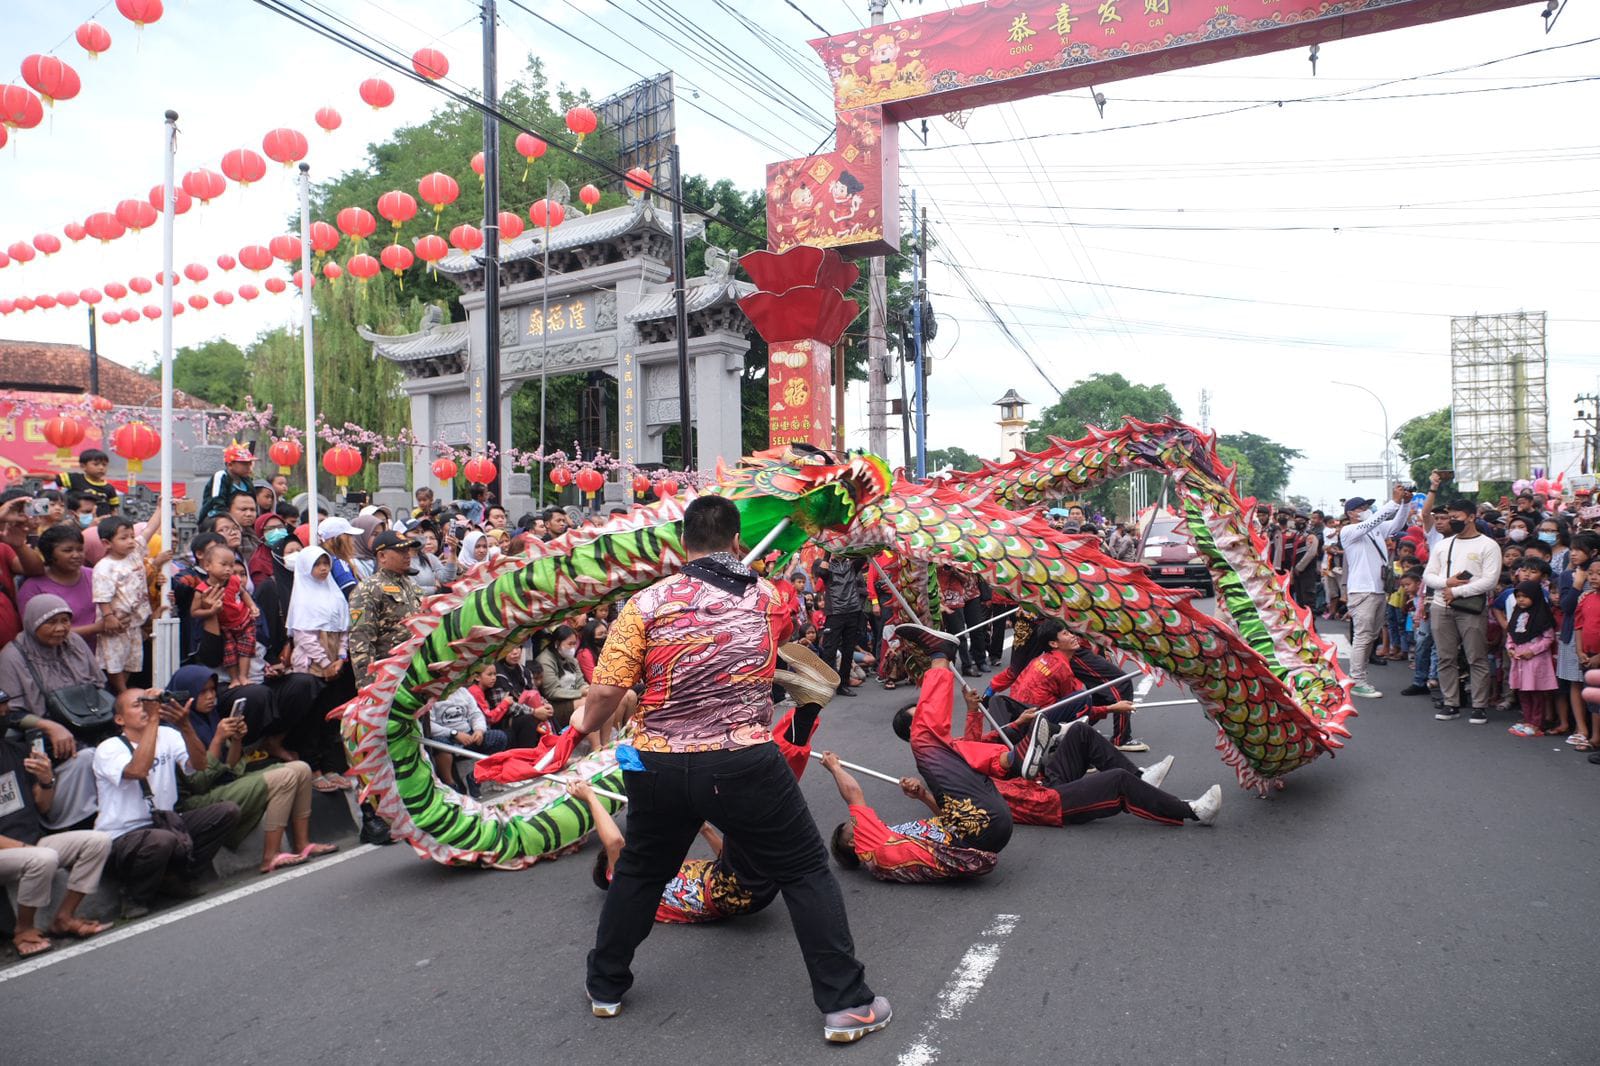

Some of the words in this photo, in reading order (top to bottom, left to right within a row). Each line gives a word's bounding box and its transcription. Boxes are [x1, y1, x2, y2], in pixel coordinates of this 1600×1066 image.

[1009, 43, 1034, 55] GONG
[1060, 36, 1070, 44] XI
[1104, 27, 1116, 36] FA
[1149, 18, 1165, 28] CAI
[1215, 4, 1229, 14] XIN
[772, 434, 808, 446] SELAMAT
